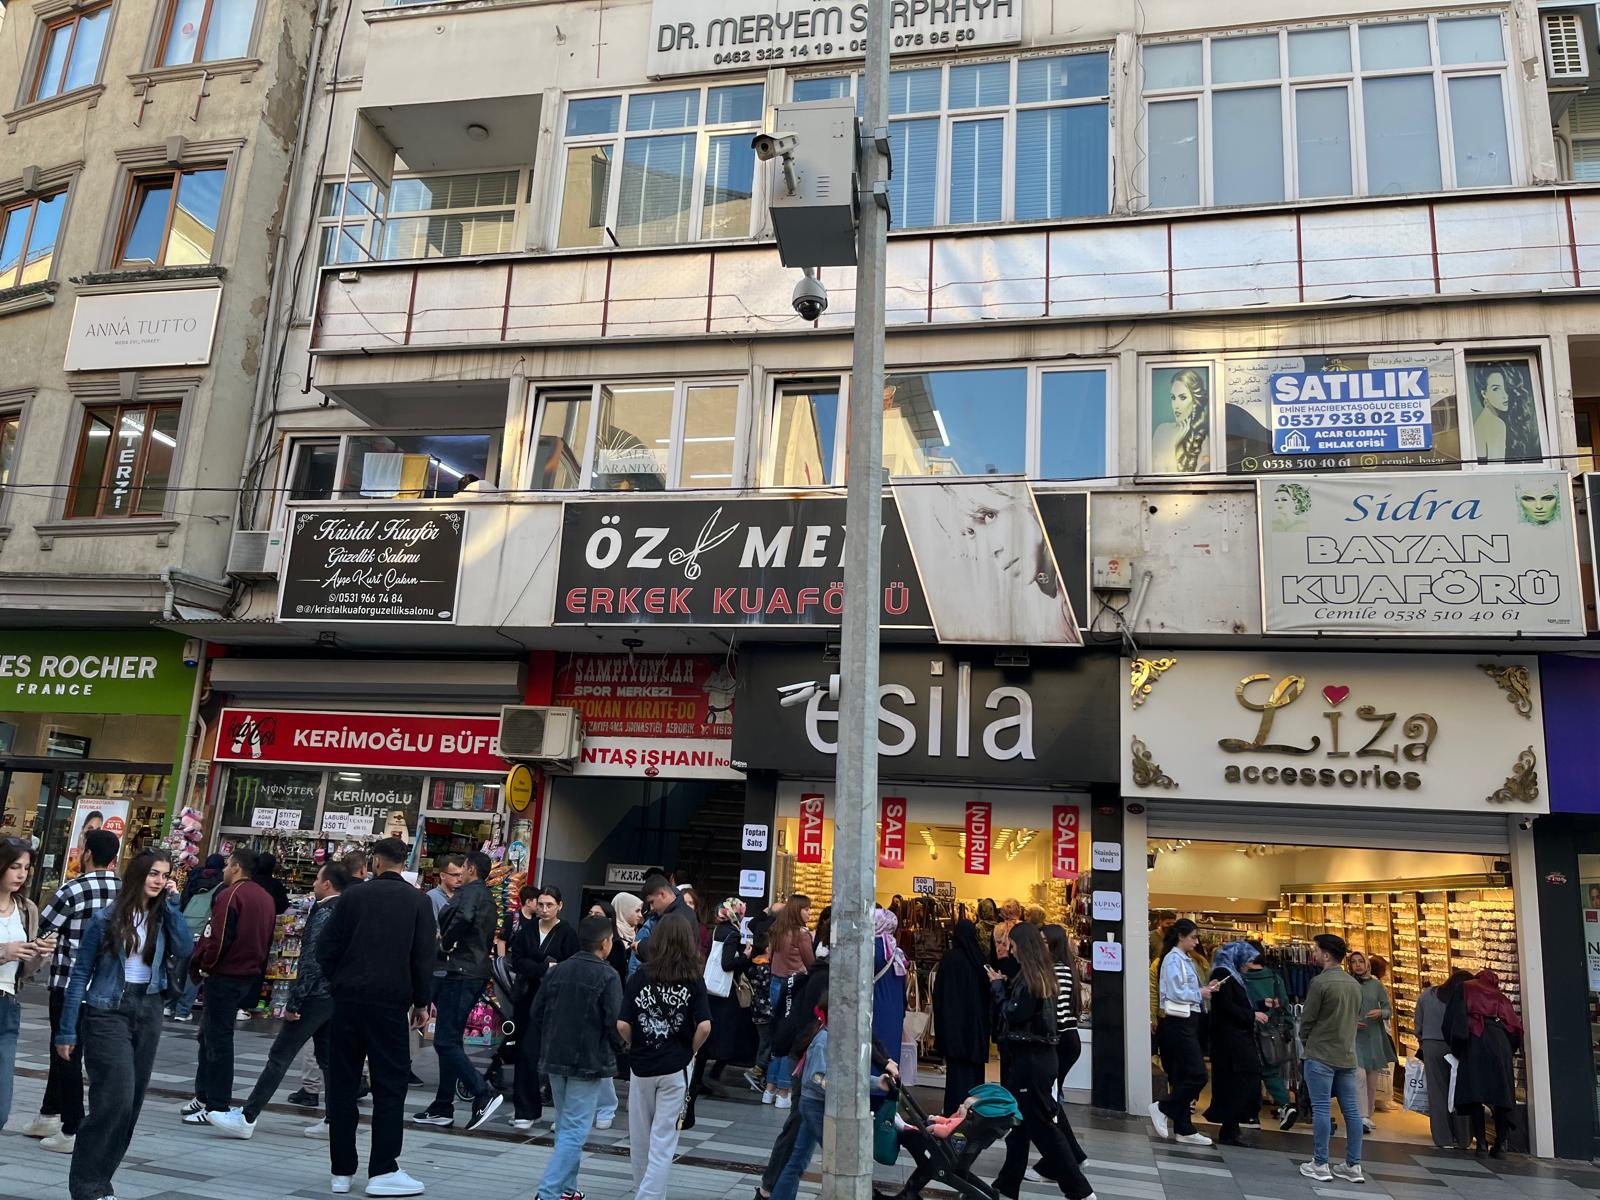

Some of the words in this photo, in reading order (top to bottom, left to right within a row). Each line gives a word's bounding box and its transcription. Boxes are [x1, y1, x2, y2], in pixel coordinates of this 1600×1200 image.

[657, 22, 700, 52] DR.
[706, 6, 843, 48] MERYEM
[713, 50, 751, 65] 0462
[756, 47, 784, 61] 322
[790, 45, 809, 58] 14
[814, 42, 833, 55] 19
[894, 33, 924, 47] 078
[929, 31, 950, 44] 95
[955, 28, 976, 41] 50
[138, 318, 197, 335] TUTTO
[1275, 370, 1425, 402] SATILIK
[1280, 405, 1306, 414] EMİNE
[1277, 413, 1325, 427] 0537
[1328, 412, 1366, 425] 938
[1370, 411, 1396, 424] 02
[1400, 410, 1425, 423] 59
[1315, 430, 1344, 439] ACAR
[1345, 429, 1388, 438] GLOBAL
[1318, 440, 1355, 450] EMLAK
[1262, 459, 1293, 469] 0538
[1344, 489, 1484, 522] Sidra
[313, 518, 380, 541] Kristal
[378, 518, 440, 547] Kuaför
[585, 515, 670, 569] ÖZ
[1306, 534, 1511, 564] BAYAN
[324, 547, 376, 569] Güzellik
[377, 547, 421, 564] Salonu
[352, 567, 384, 590] Kurt
[1281, 568, 1561, 606] KUAFÖRÜ
[361, 593, 376, 604] 966
[378, 593, 389, 604] 74
[391, 594, 403, 604] 84
[566, 587, 694, 614] ERKEK
[712, 581, 909, 615] KUAFÖÜ
[1314, 607, 1377, 620] Cemile
[1383, 608, 1428, 621] 0538
[1431, 609, 1463, 622] 510
[1468, 611, 1494, 622] 40
[1501, 609, 1521, 621] 61
[0, 655, 32, 678] ES
[39, 655, 158, 680] ROCHER
[16, 683, 93, 696] FRANCE
[574, 686, 612, 697] SPOR
[1217, 671, 1440, 763] Liza
[292, 725, 434, 754] KERİMOĞLU
[715, 757, 730, 767] No
[1223, 763, 1422, 790] accessories
[333, 787, 413, 805] KERİMOĞLU
[279, 811, 300, 819] STITCH
[353, 804, 389, 819] BÜFE
[278, 819, 289, 827] 450
[290, 820, 297, 828] TL
[323, 821, 337, 829] 350
[337, 822, 347, 830] TL
[803, 798, 822, 856] SALE
[745, 828, 767, 838] Toptan
[884, 804, 904, 861] SALE
[970, 805, 989, 872] İNDİRİM
[1057, 812, 1076, 872] SALE
[1094, 848, 1120, 857] Stainless
[1099, 856, 1114, 864] steel
[917, 884, 933, 892] 350
[1093, 900, 1121, 909] XUPING
